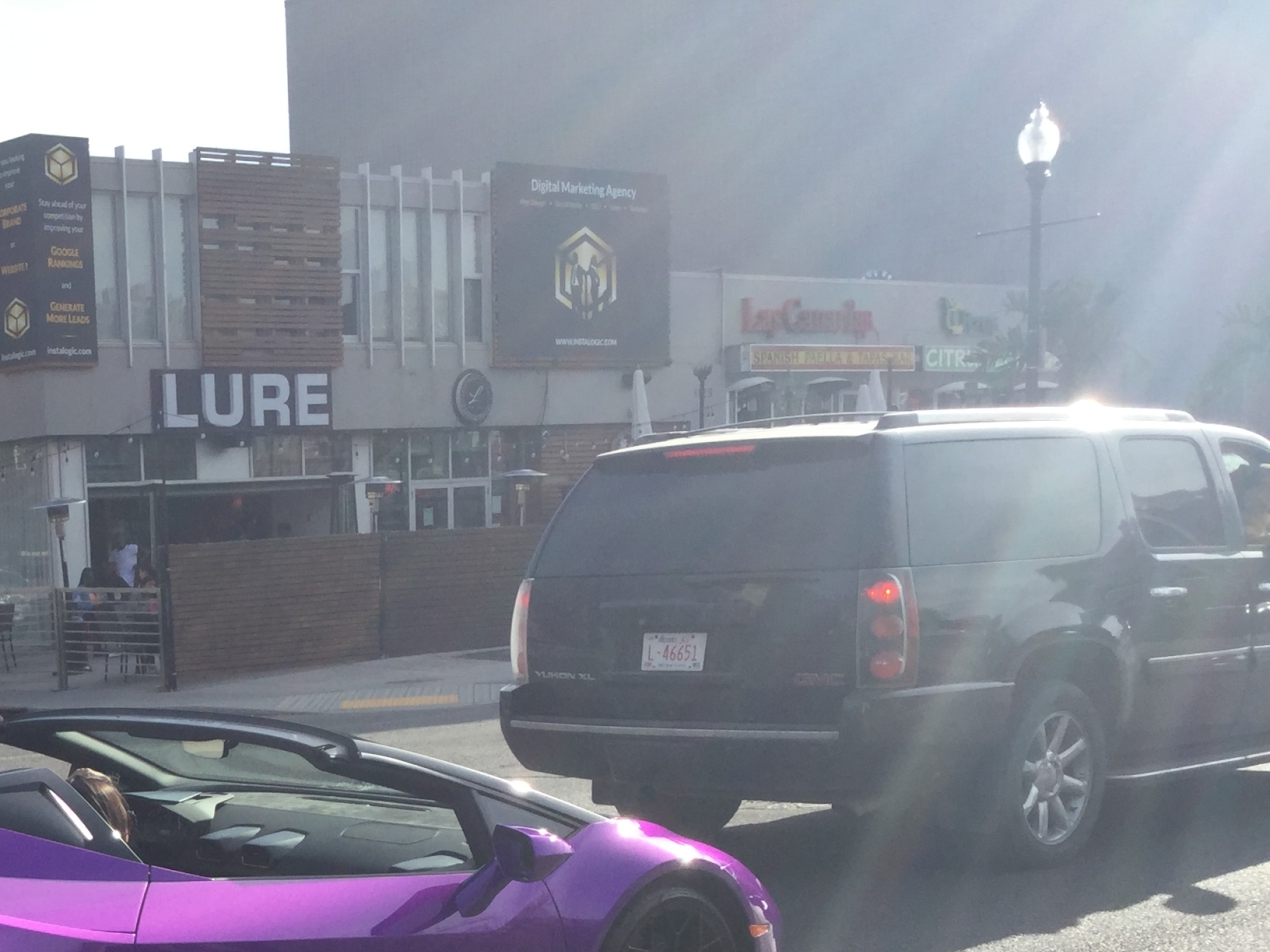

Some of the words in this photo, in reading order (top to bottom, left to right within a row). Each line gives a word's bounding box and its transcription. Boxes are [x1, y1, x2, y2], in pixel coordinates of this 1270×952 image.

[531, 178, 560, 194] Digital
[561, 181, 605, 198] Marketing
[606, 184, 637, 200] Agency
[38, 198, 51, 208] Stay
[51, 199, 68, 209] ahead
[68, 200, 74, 209] of
[43, 212, 76, 221] competition
[43, 223, 71, 234] improving
[61, 281, 72, 290] and
[46, 346, 93, 357] instalogic.com
[753, 351, 799, 365] SPANISH
[804, 351, 842, 365] PAELLA
[162, 373, 330, 429] LURE
[534, 670, 576, 680] YUKON
[578, 673, 596, 682] XL
